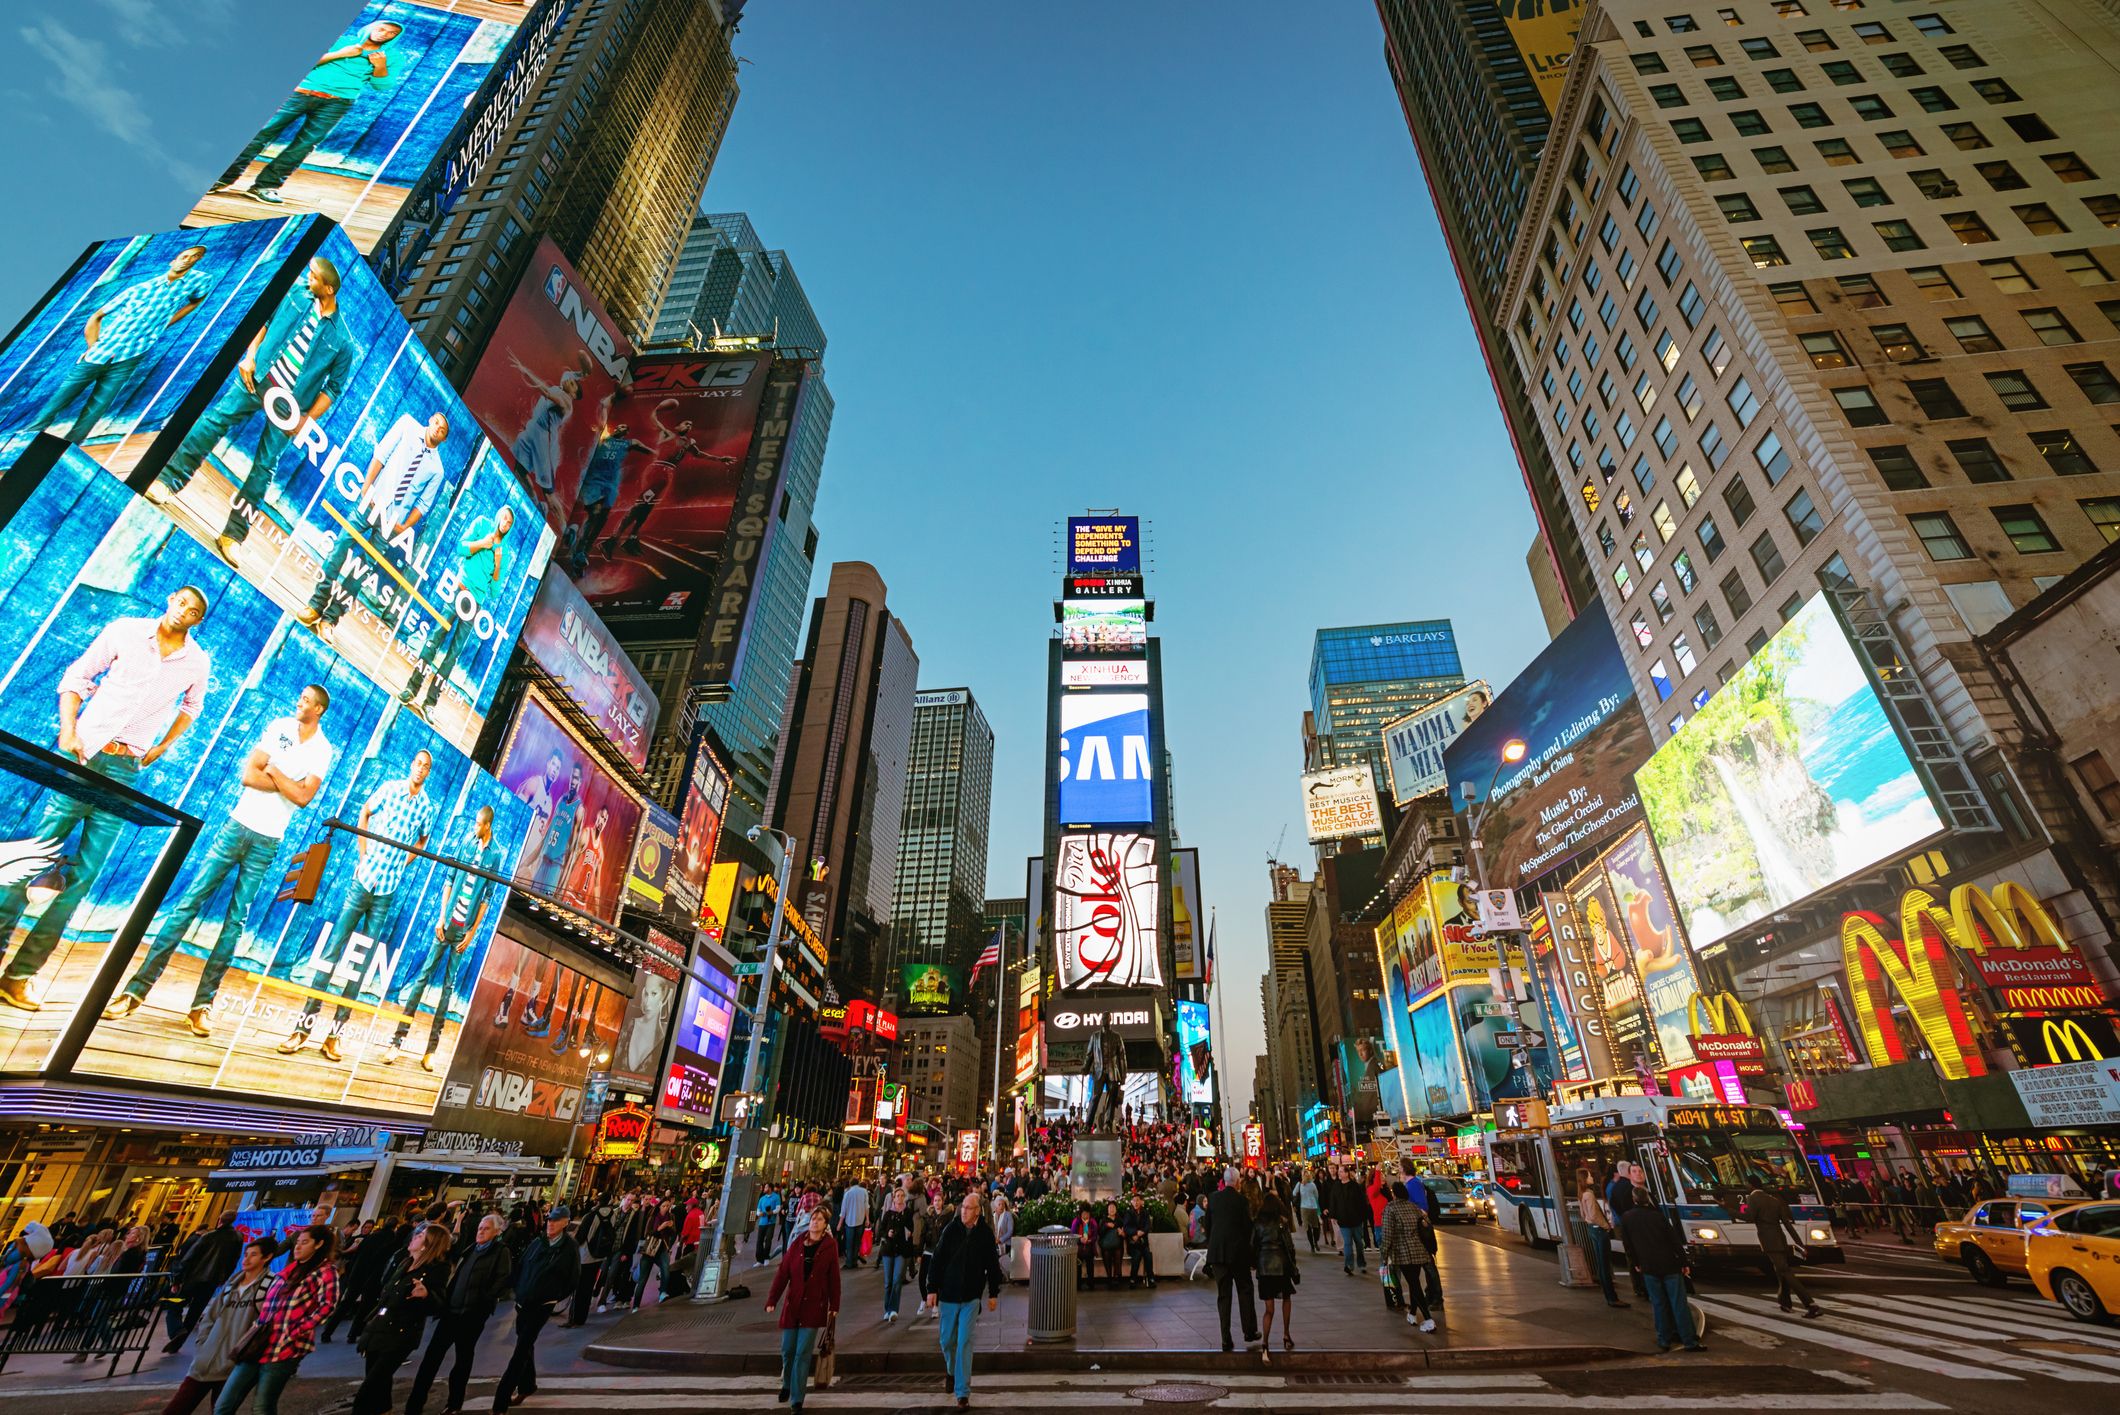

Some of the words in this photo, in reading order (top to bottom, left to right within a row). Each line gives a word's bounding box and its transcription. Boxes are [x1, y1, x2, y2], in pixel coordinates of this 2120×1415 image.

[447, 47, 528, 195] AMERICAN
[528, 0, 566, 66] EAGLE
[468, 43, 549, 188] OUTFITTERS
[558, 284, 630, 384] NBA
[634, 359, 756, 391] 2K13
[700, 390, 727, 398] JAY
[730, 389, 743, 398] Z
[754, 381, 797, 481] TIMES
[264, 386, 434, 581] ORIGINAL
[435, 569, 510, 654] BOOT
[1114, 525, 1127, 533] MY
[710, 494, 770, 645] SQUARE
[228, 490, 327, 584] UNLIMITED
[329, 578, 372, 627] WAYS
[373, 618, 393, 644] TO
[393, 638, 433, 681] WEAR
[432, 671, 466, 706] THEM
[323, 528, 339, 554] 6
[338, 548, 433, 649] WASHES.
[1075, 586, 1132, 594] GALLERY
[567, 613, 609, 677] NBA
[1385, 631, 1446, 645] BARCLAYS
[703, 662, 726, 671] NYC
[1081, 665, 1129, 674] XINHUA
[914, 695, 946, 704] Allianz
[608, 704, 633, 735] JAY
[628, 730, 640, 746] Z
[1391, 710, 1458, 761] MAMMA
[1409, 741, 1445, 782] MIA
[1491, 755, 1541, 803] Photography
[1542, 737, 1562, 760] and
[1561, 709, 1601, 747] Editing
[1599, 692, 1620, 716] By:
[1533, 769, 1551, 788] Ross
[1550, 751, 1575, 775] Ching
[1310, 800, 1330, 809] BEST
[1333, 794, 1372, 805] MUSICAL
[1312, 813, 1358, 827] MUSICAL
[1360, 810, 1375, 820] OF
[1339, 801, 1372, 815] BEST
[1539, 795, 1570, 826] Music
[1568, 785, 1589, 806] By:
[1314, 824, 1333, 833] THIS
[1519, 793, 1639, 876] MySpace.com/TheGhostOrchid
[1536, 829, 1552, 846] The
[1551, 816, 1576, 836] Ghost
[1574, 794, 1604, 821] Orchid
[1064, 841, 1084, 889] Diet
[1078, 848, 1123, 973] Coke
[307, 920, 401, 993] LEN
[1461, 944, 1469, 954] If
[1470, 943, 1487, 953] You
[1981, 957, 2083, 973] McDonald's
[742, 966, 749, 974] 46
[1554, 902, 1602, 1036] PALACE
[2004, 972, 2072, 982] Restaurant
[1602, 970, 1639, 1011] Annie
[217, 994, 284, 1023] STYLIST
[283, 1010, 329, 1032] FROM
[1500, 1036, 1514, 1044] ONE
[1697, 1040, 1759, 1051] McDonald's
[504, 1049, 527, 1064] ENTER
[527, 1054, 539, 1069] THE
[849, 1055, 881, 1076] EY'S
[484, 1070, 535, 1112] NBA
[525, 1081, 581, 1120] 2K13
[294, 1126, 377, 1147] snackBOX
[438, 1132, 457, 1149] HOT
[456, 1133, 480, 1150] DOGS
[228, 1158, 250, 1168] best
[249, 1151, 279, 1168] HOT
[278, 1149, 320, 1166] DOGS
[226, 1180, 239, 1188] HOT
[239, 1180, 257, 1188] DOGS
[275, 1178, 299, 1186] COFFEE
